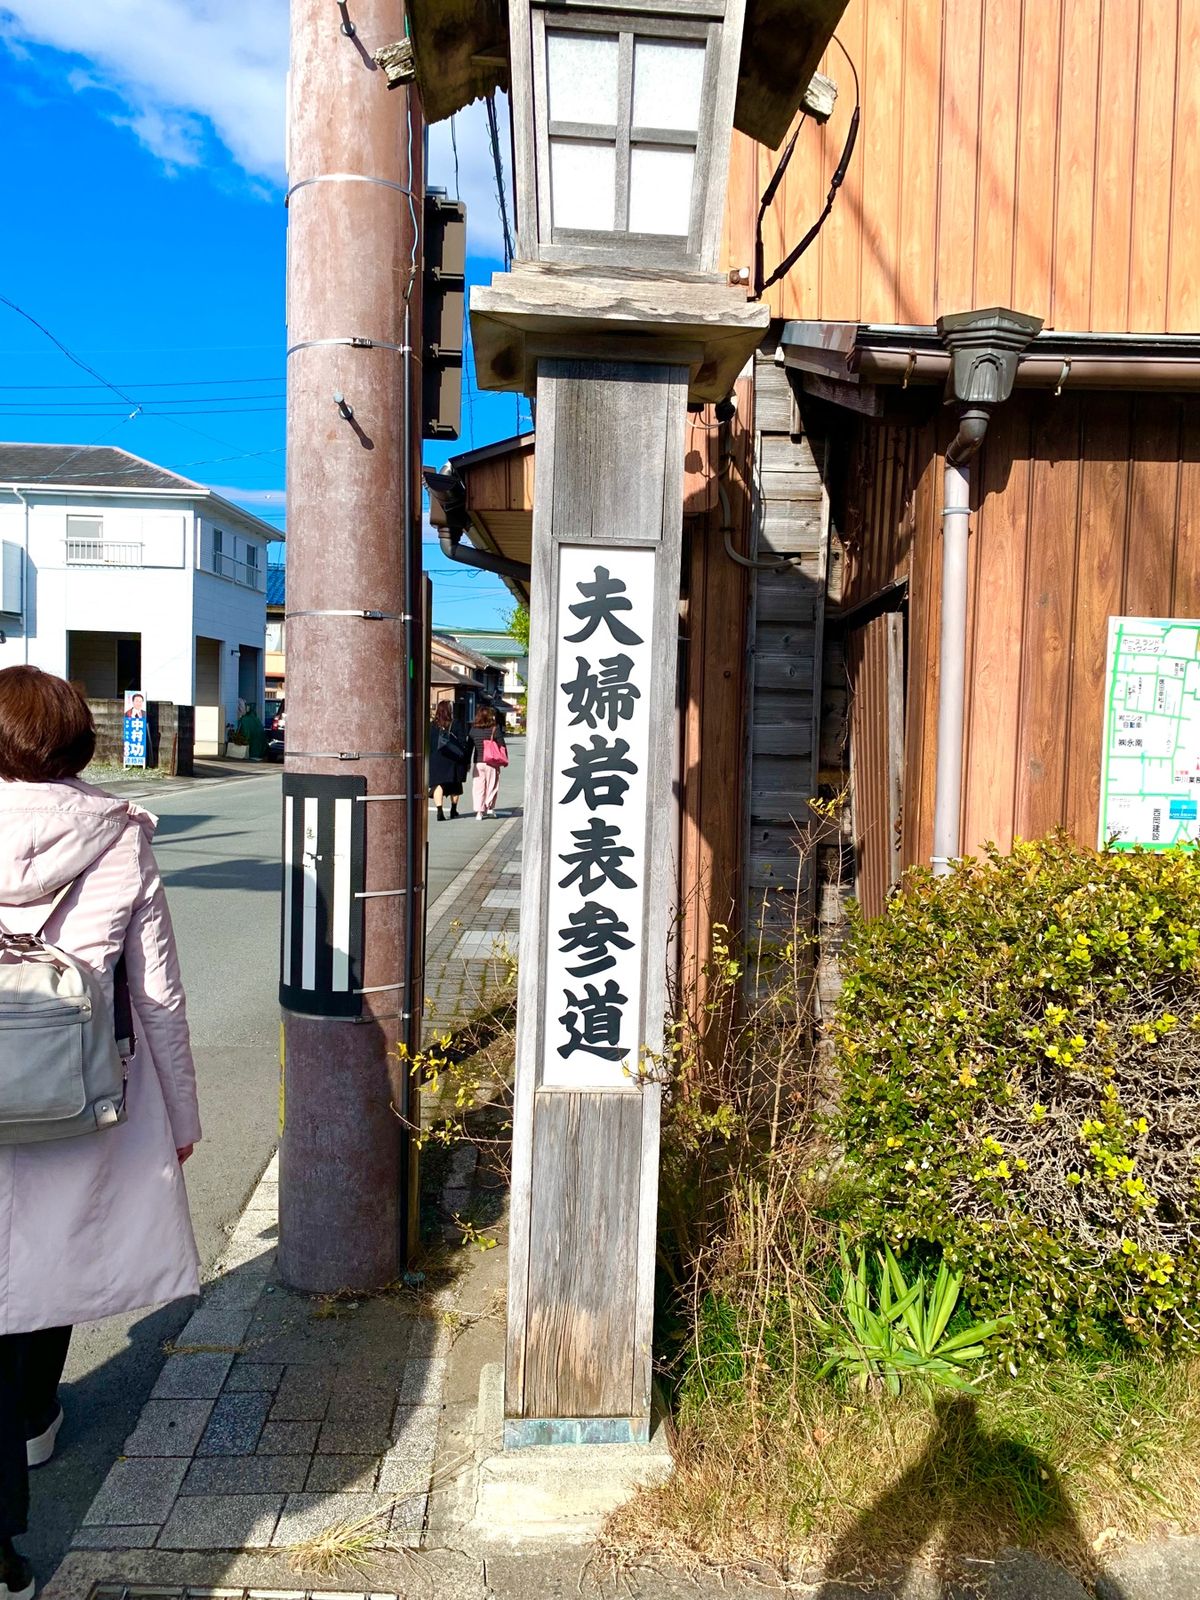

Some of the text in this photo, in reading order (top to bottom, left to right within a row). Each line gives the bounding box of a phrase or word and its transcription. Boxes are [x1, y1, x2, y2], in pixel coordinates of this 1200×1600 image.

[131, 719, 144, 756] 中村功
[556, 565, 645, 1063] 夫婦岩表参道
